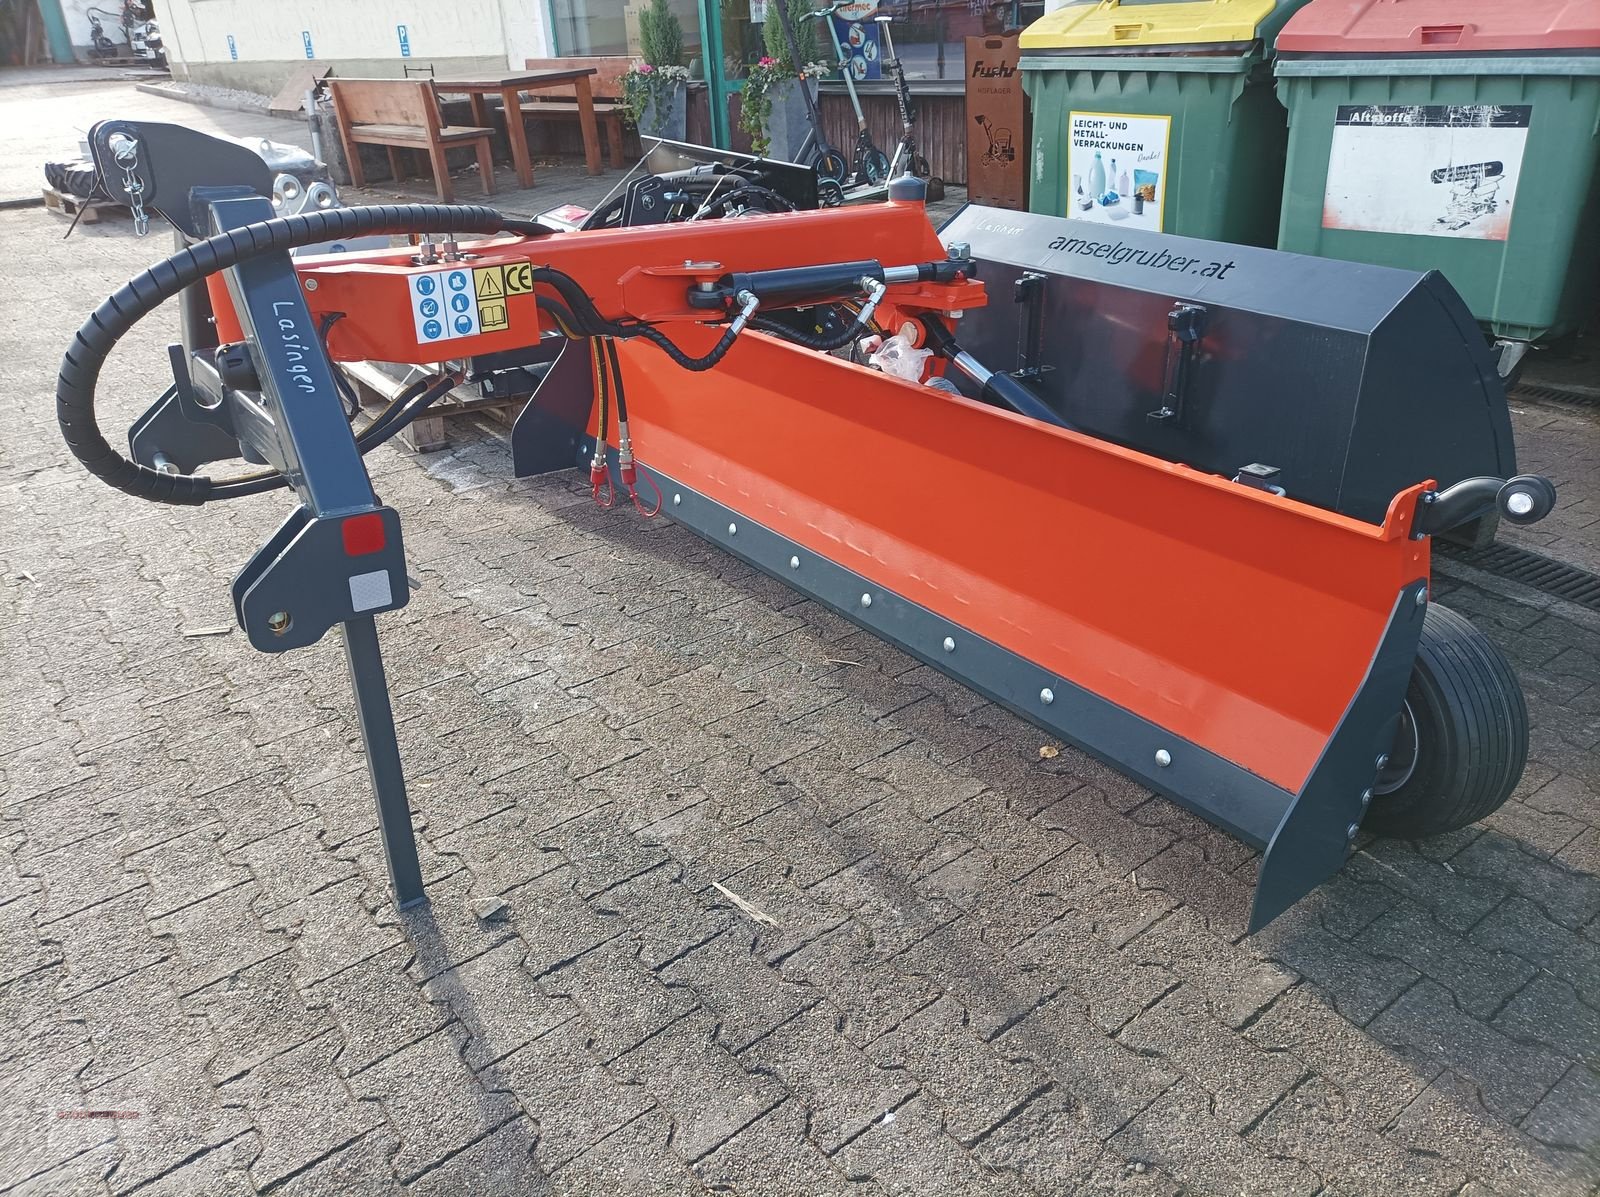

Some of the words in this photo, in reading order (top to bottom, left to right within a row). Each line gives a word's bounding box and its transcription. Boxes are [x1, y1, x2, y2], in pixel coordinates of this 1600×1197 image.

[1073, 129, 1108, 139] METALL-
[1074, 120, 1106, 129] LEICHT-
[1109, 121, 1128, 130] UND
[1073, 139, 1144, 151] VERPACKUNGEN
[1048, 235, 1235, 280] amselgruber.at
[506, 264, 532, 292] CE
[272, 301, 316, 393] Lasinger
